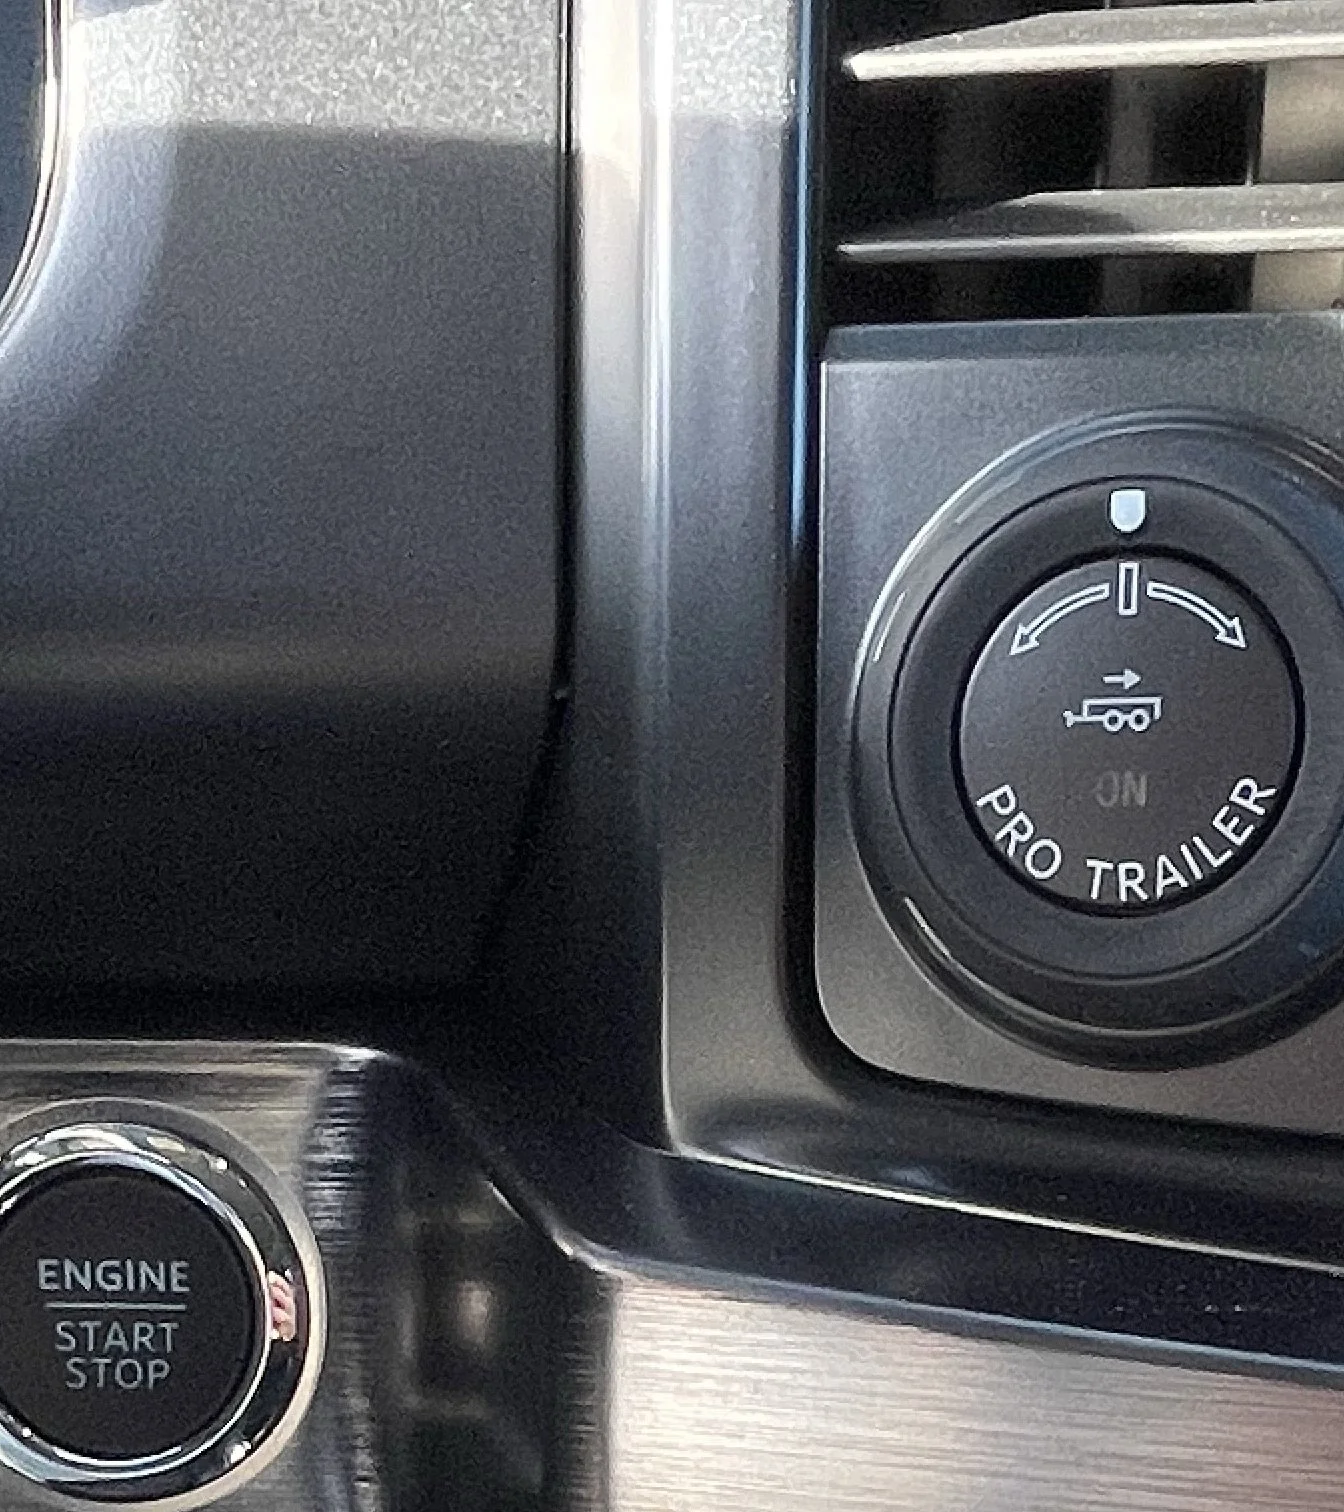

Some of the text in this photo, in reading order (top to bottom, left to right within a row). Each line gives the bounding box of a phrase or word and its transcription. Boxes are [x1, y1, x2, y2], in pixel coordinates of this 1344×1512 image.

[1096, 769, 1148, 808] ON
[976, 776, 1277, 902] PRO TRAILER
[38, 1258, 191, 1294] ENGINE
[56, 1321, 180, 1353] START
[65, 1358, 170, 1391] STOP
